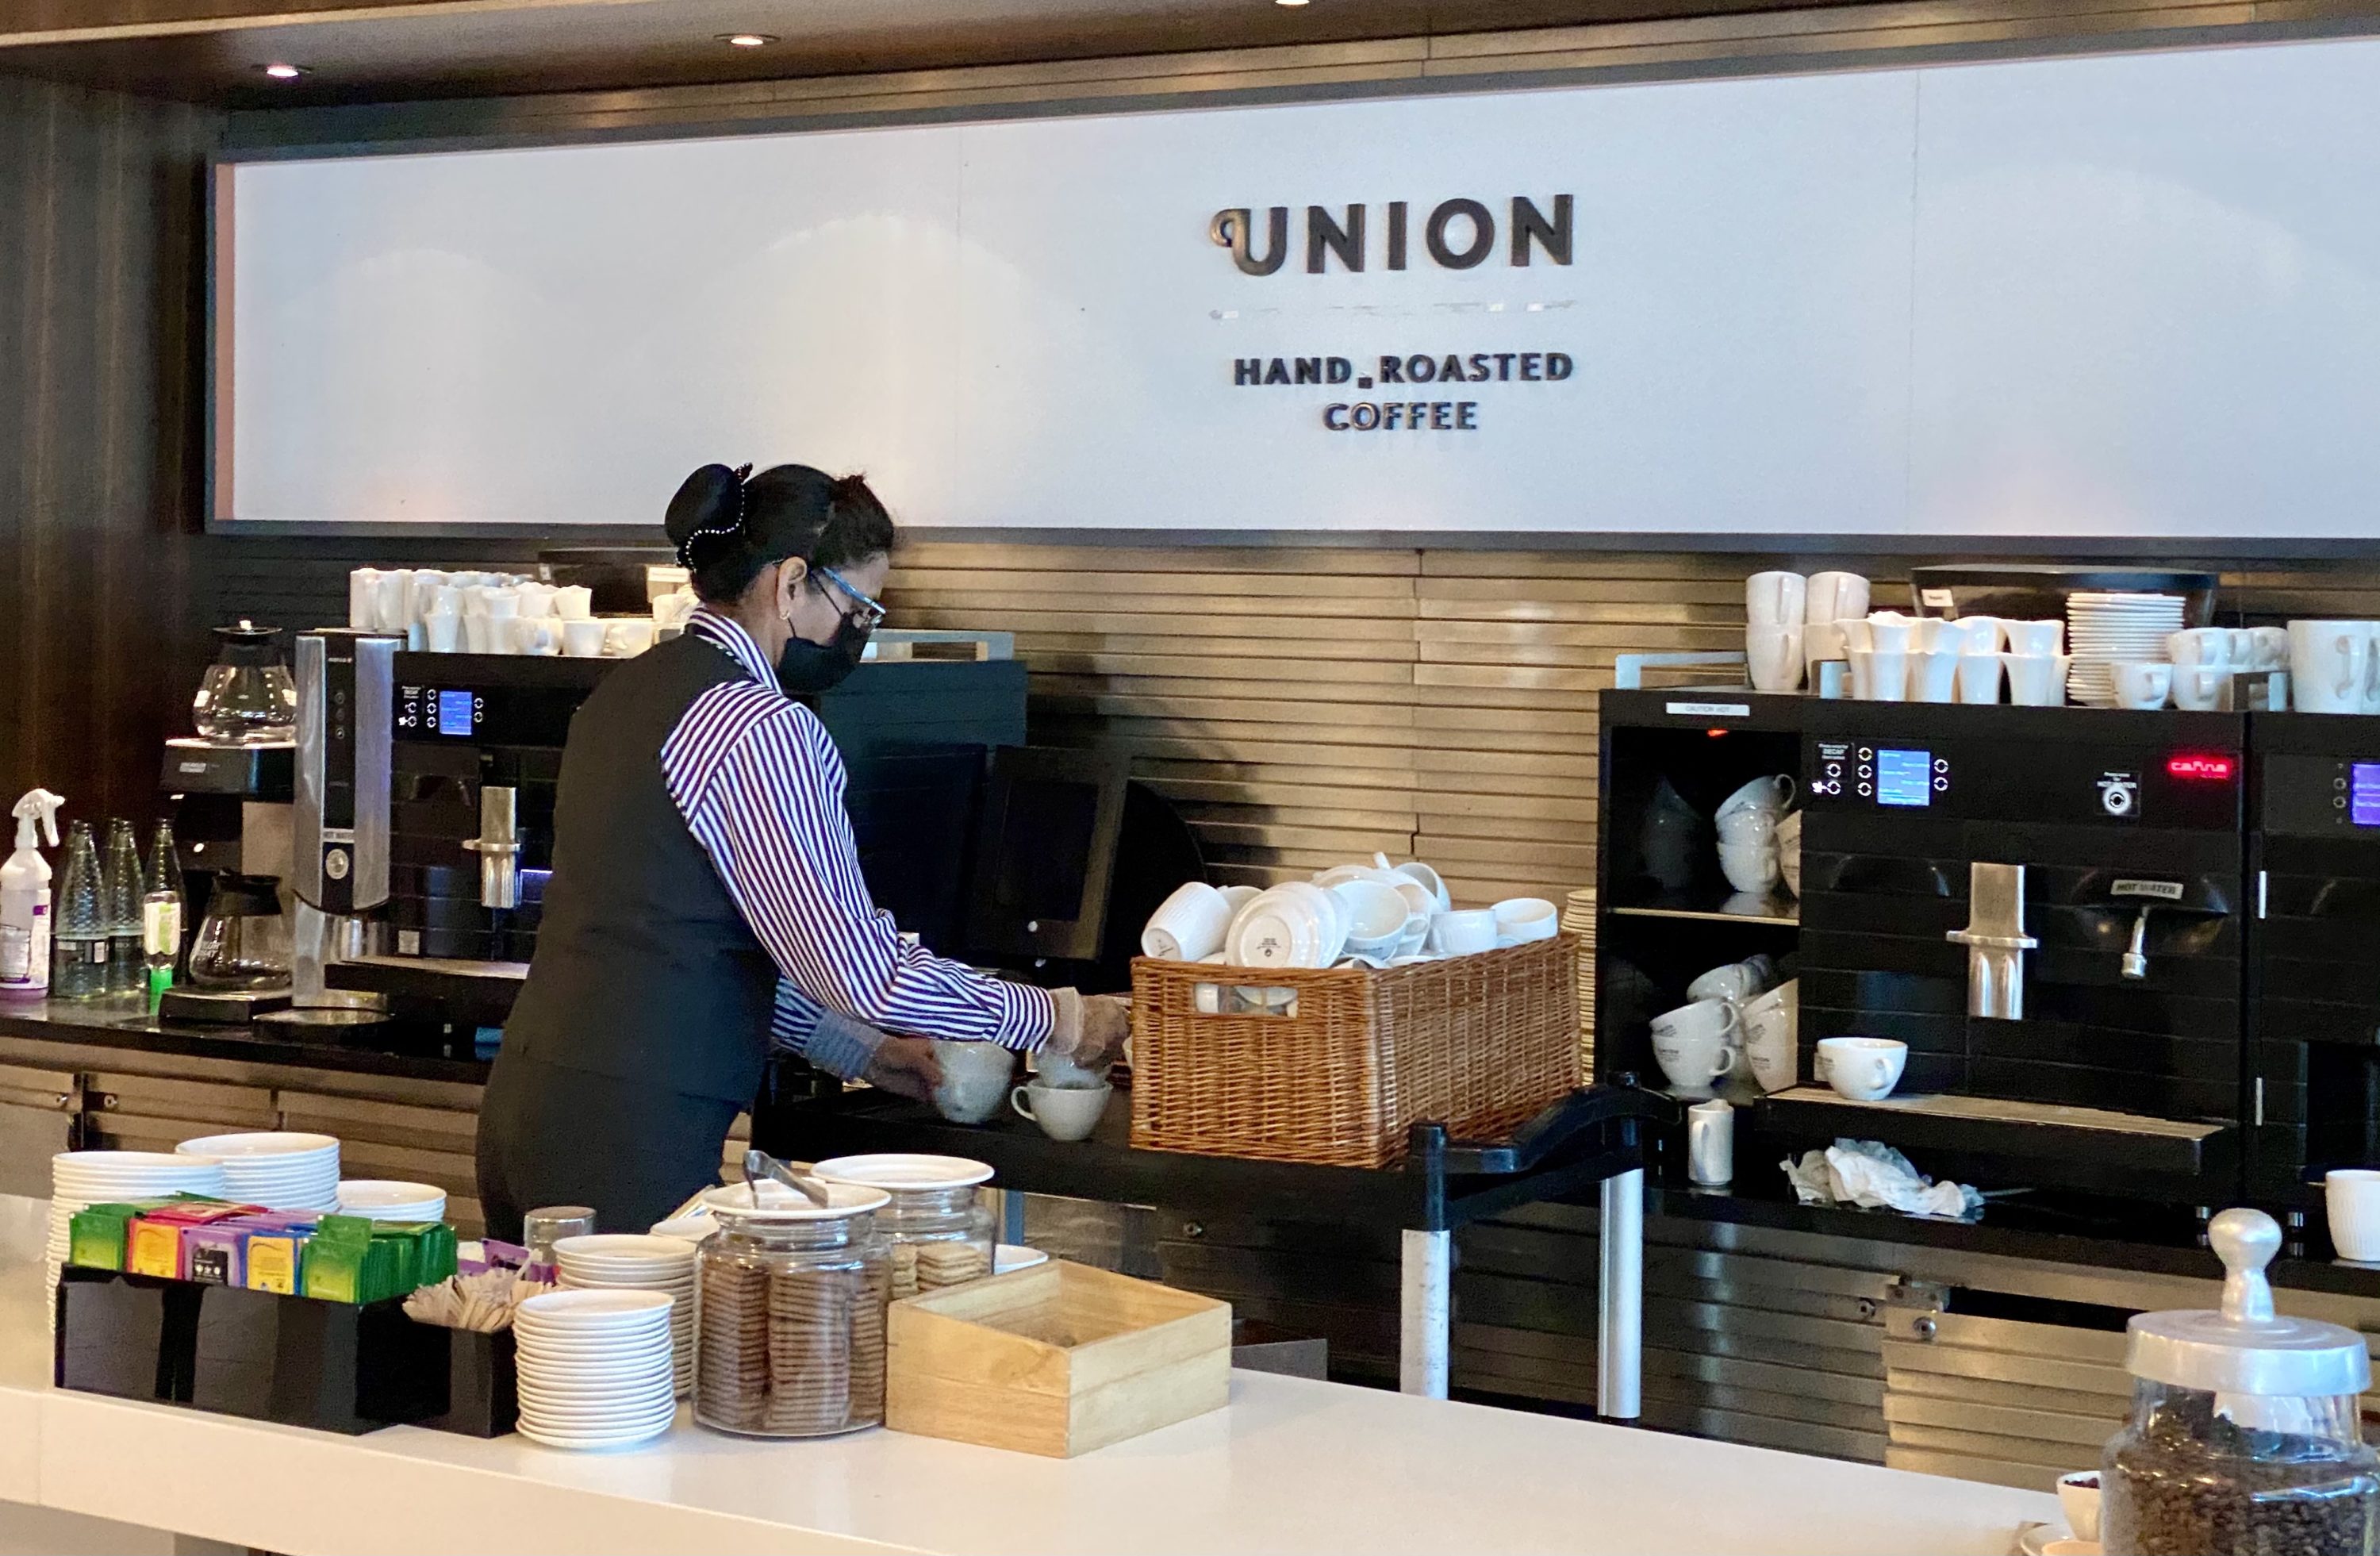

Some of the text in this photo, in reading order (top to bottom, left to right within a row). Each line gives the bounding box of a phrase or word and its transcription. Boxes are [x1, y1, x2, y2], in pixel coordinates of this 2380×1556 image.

[1210, 194, 1574, 276] UNION
[1322, 401, 1478, 431] COFFEE
[2117, 882, 2138, 891] HOT
